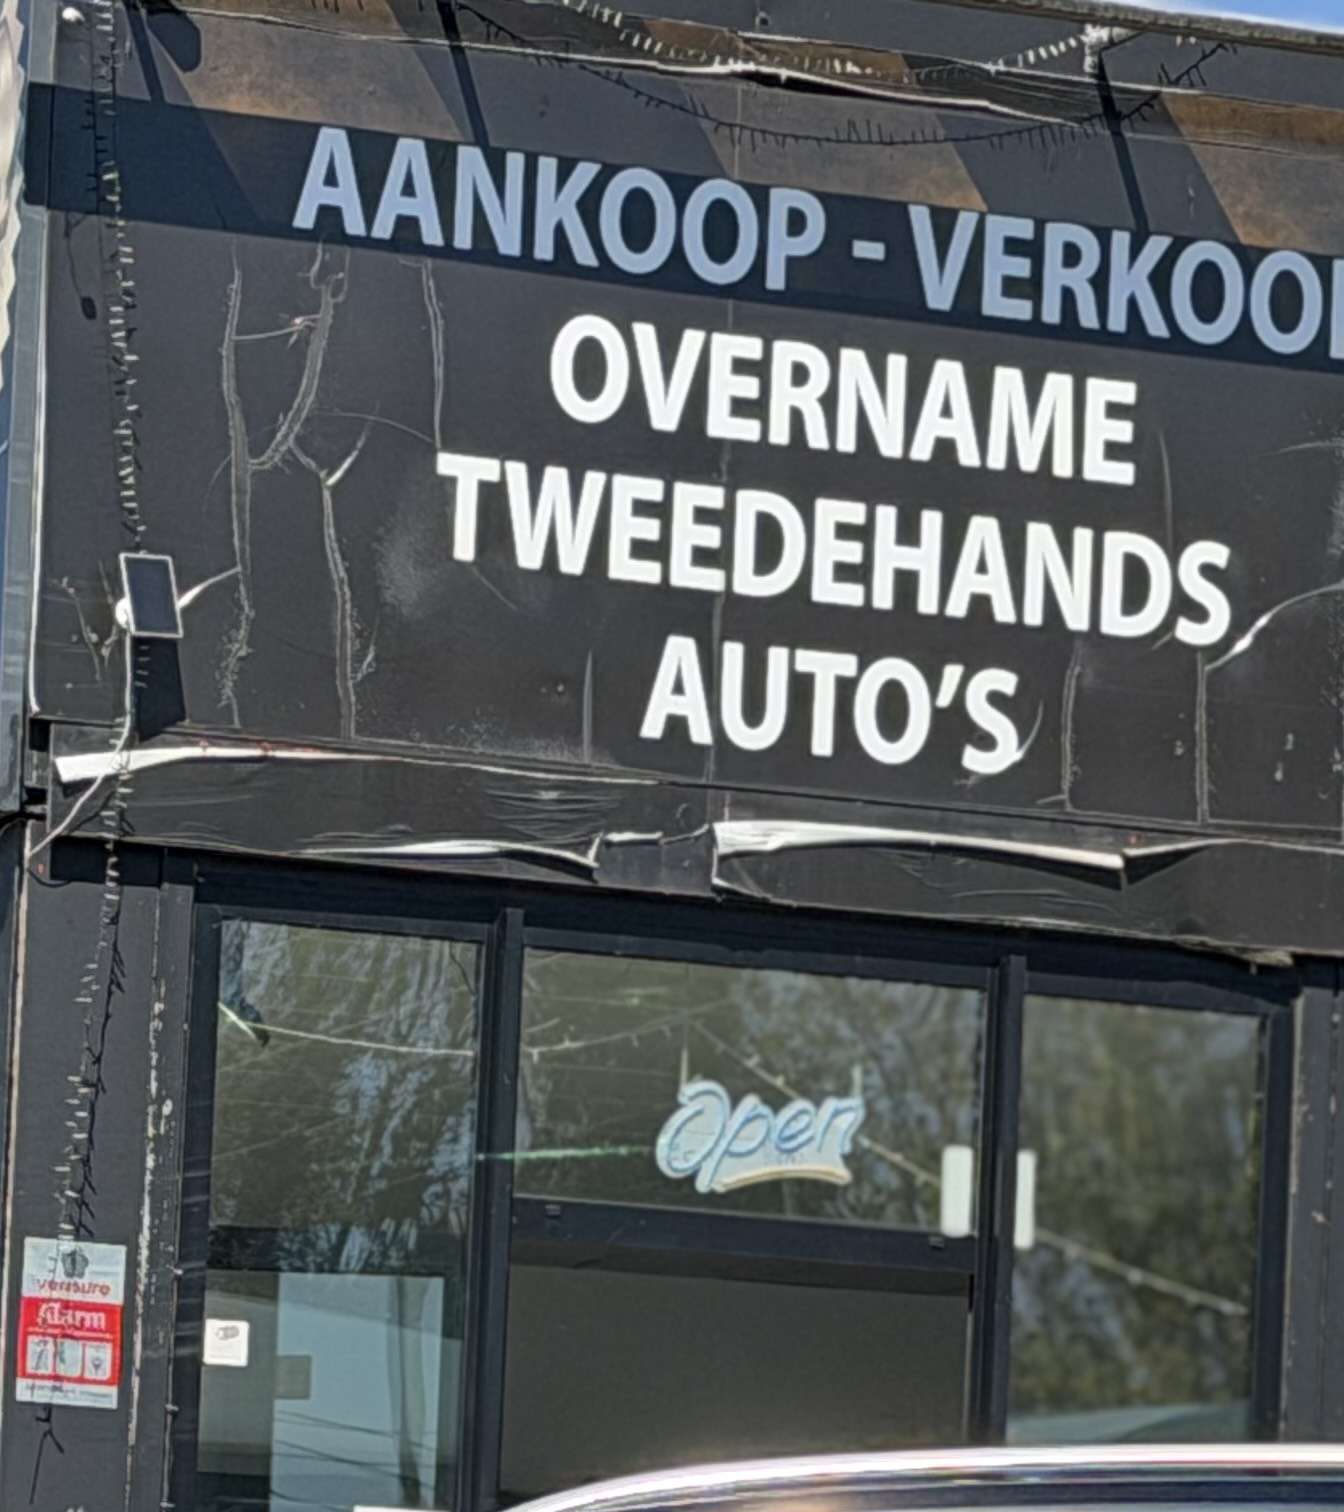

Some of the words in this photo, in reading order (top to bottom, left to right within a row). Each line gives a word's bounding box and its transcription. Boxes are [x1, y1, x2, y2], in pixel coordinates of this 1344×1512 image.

[291, 126, 827, 292] AANKOOP
[549, 313, 1137, 486] OVERNAME
[435, 451, 1233, 647] TWEEDEHANDS
[639, 635, 1020, 775] AUTO'S
[656, 1080, 865, 1194] Open
